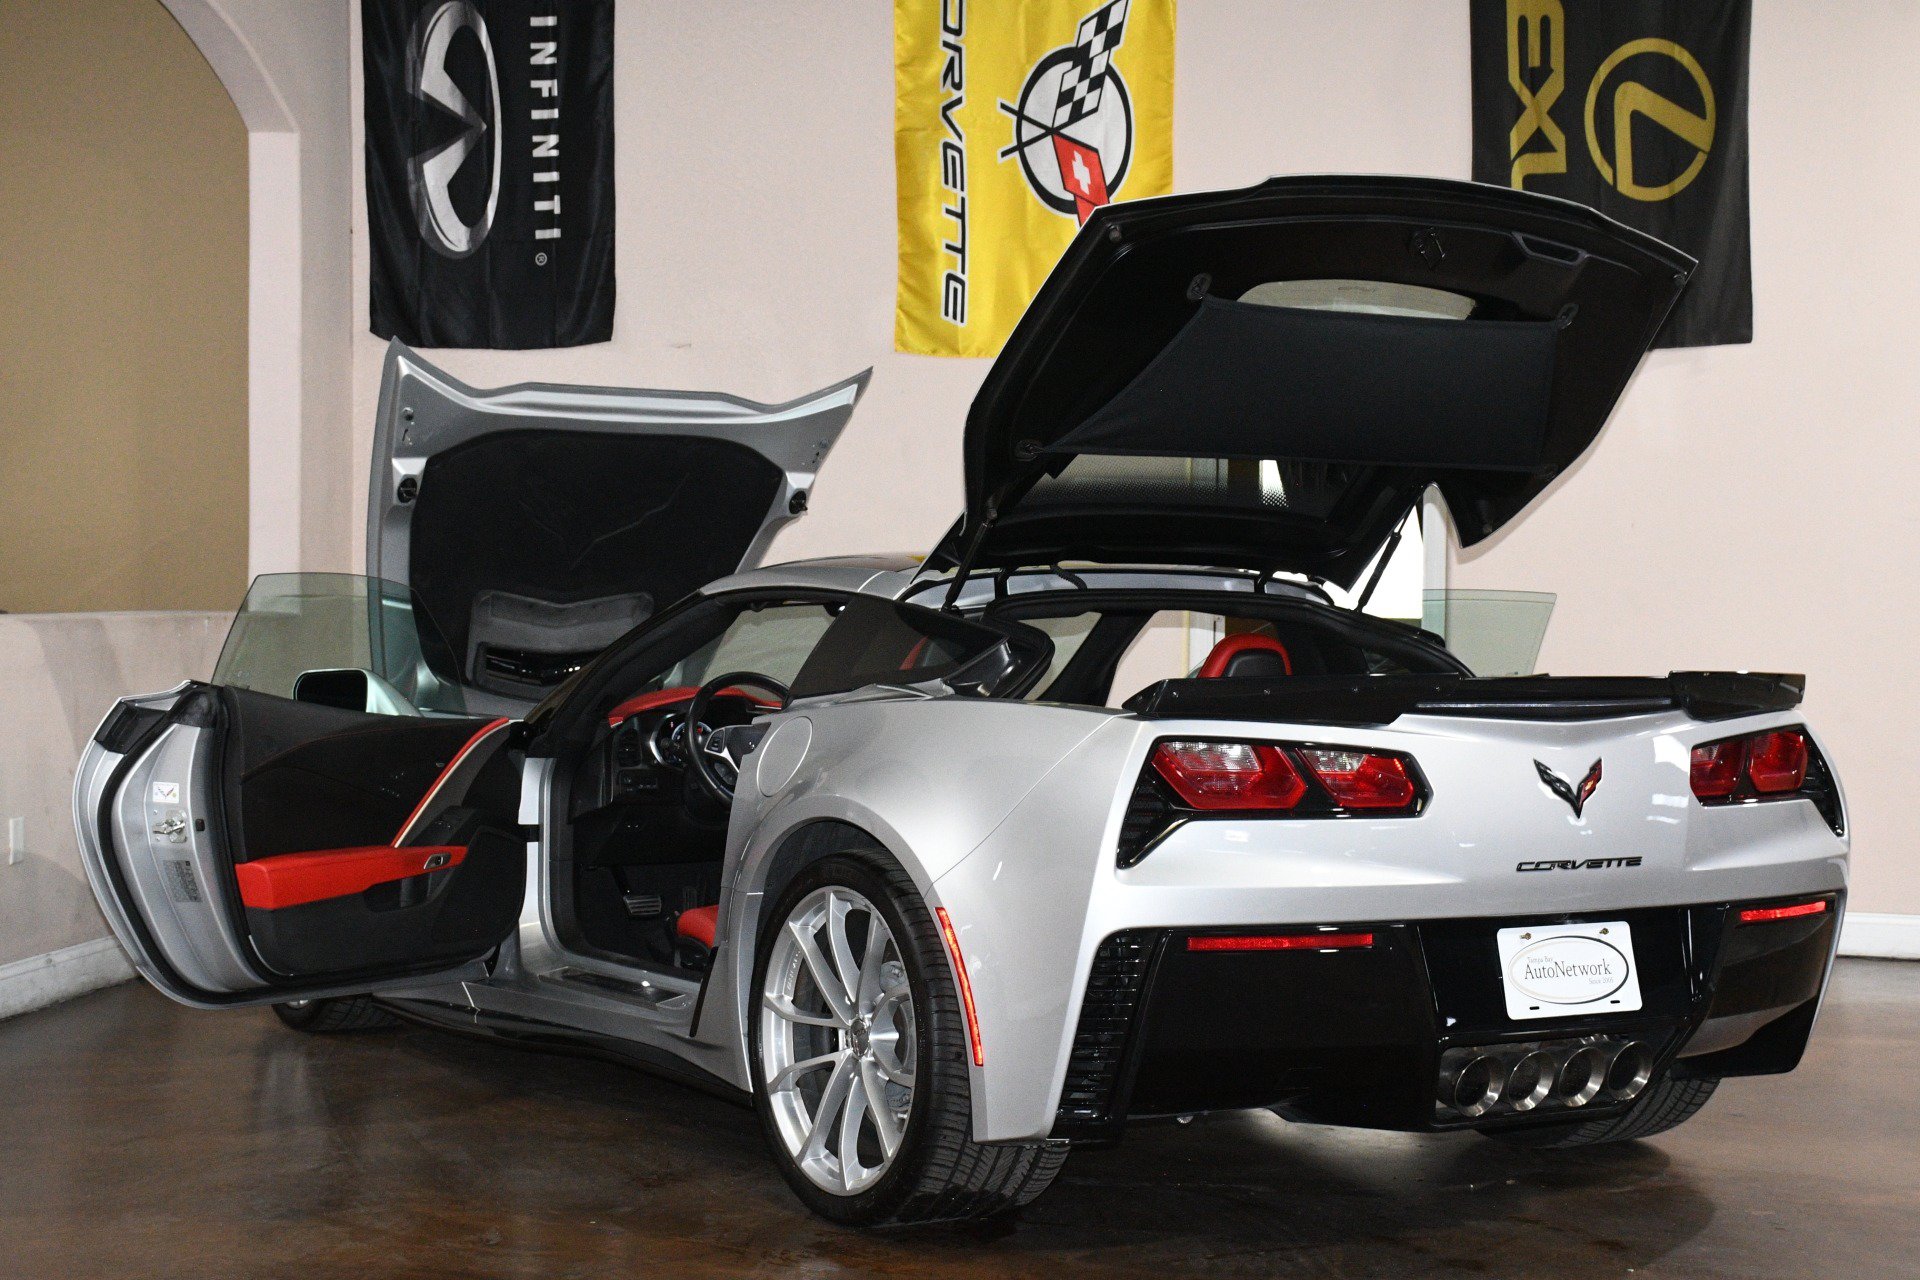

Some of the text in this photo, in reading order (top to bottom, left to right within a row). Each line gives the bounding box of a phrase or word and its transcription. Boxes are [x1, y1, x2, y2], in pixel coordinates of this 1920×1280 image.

[530, 16, 561, 240] INFINITI
[1516, 856, 1643, 872] CORVETTE
[1524, 958, 1612, 980] AutoNetwork
